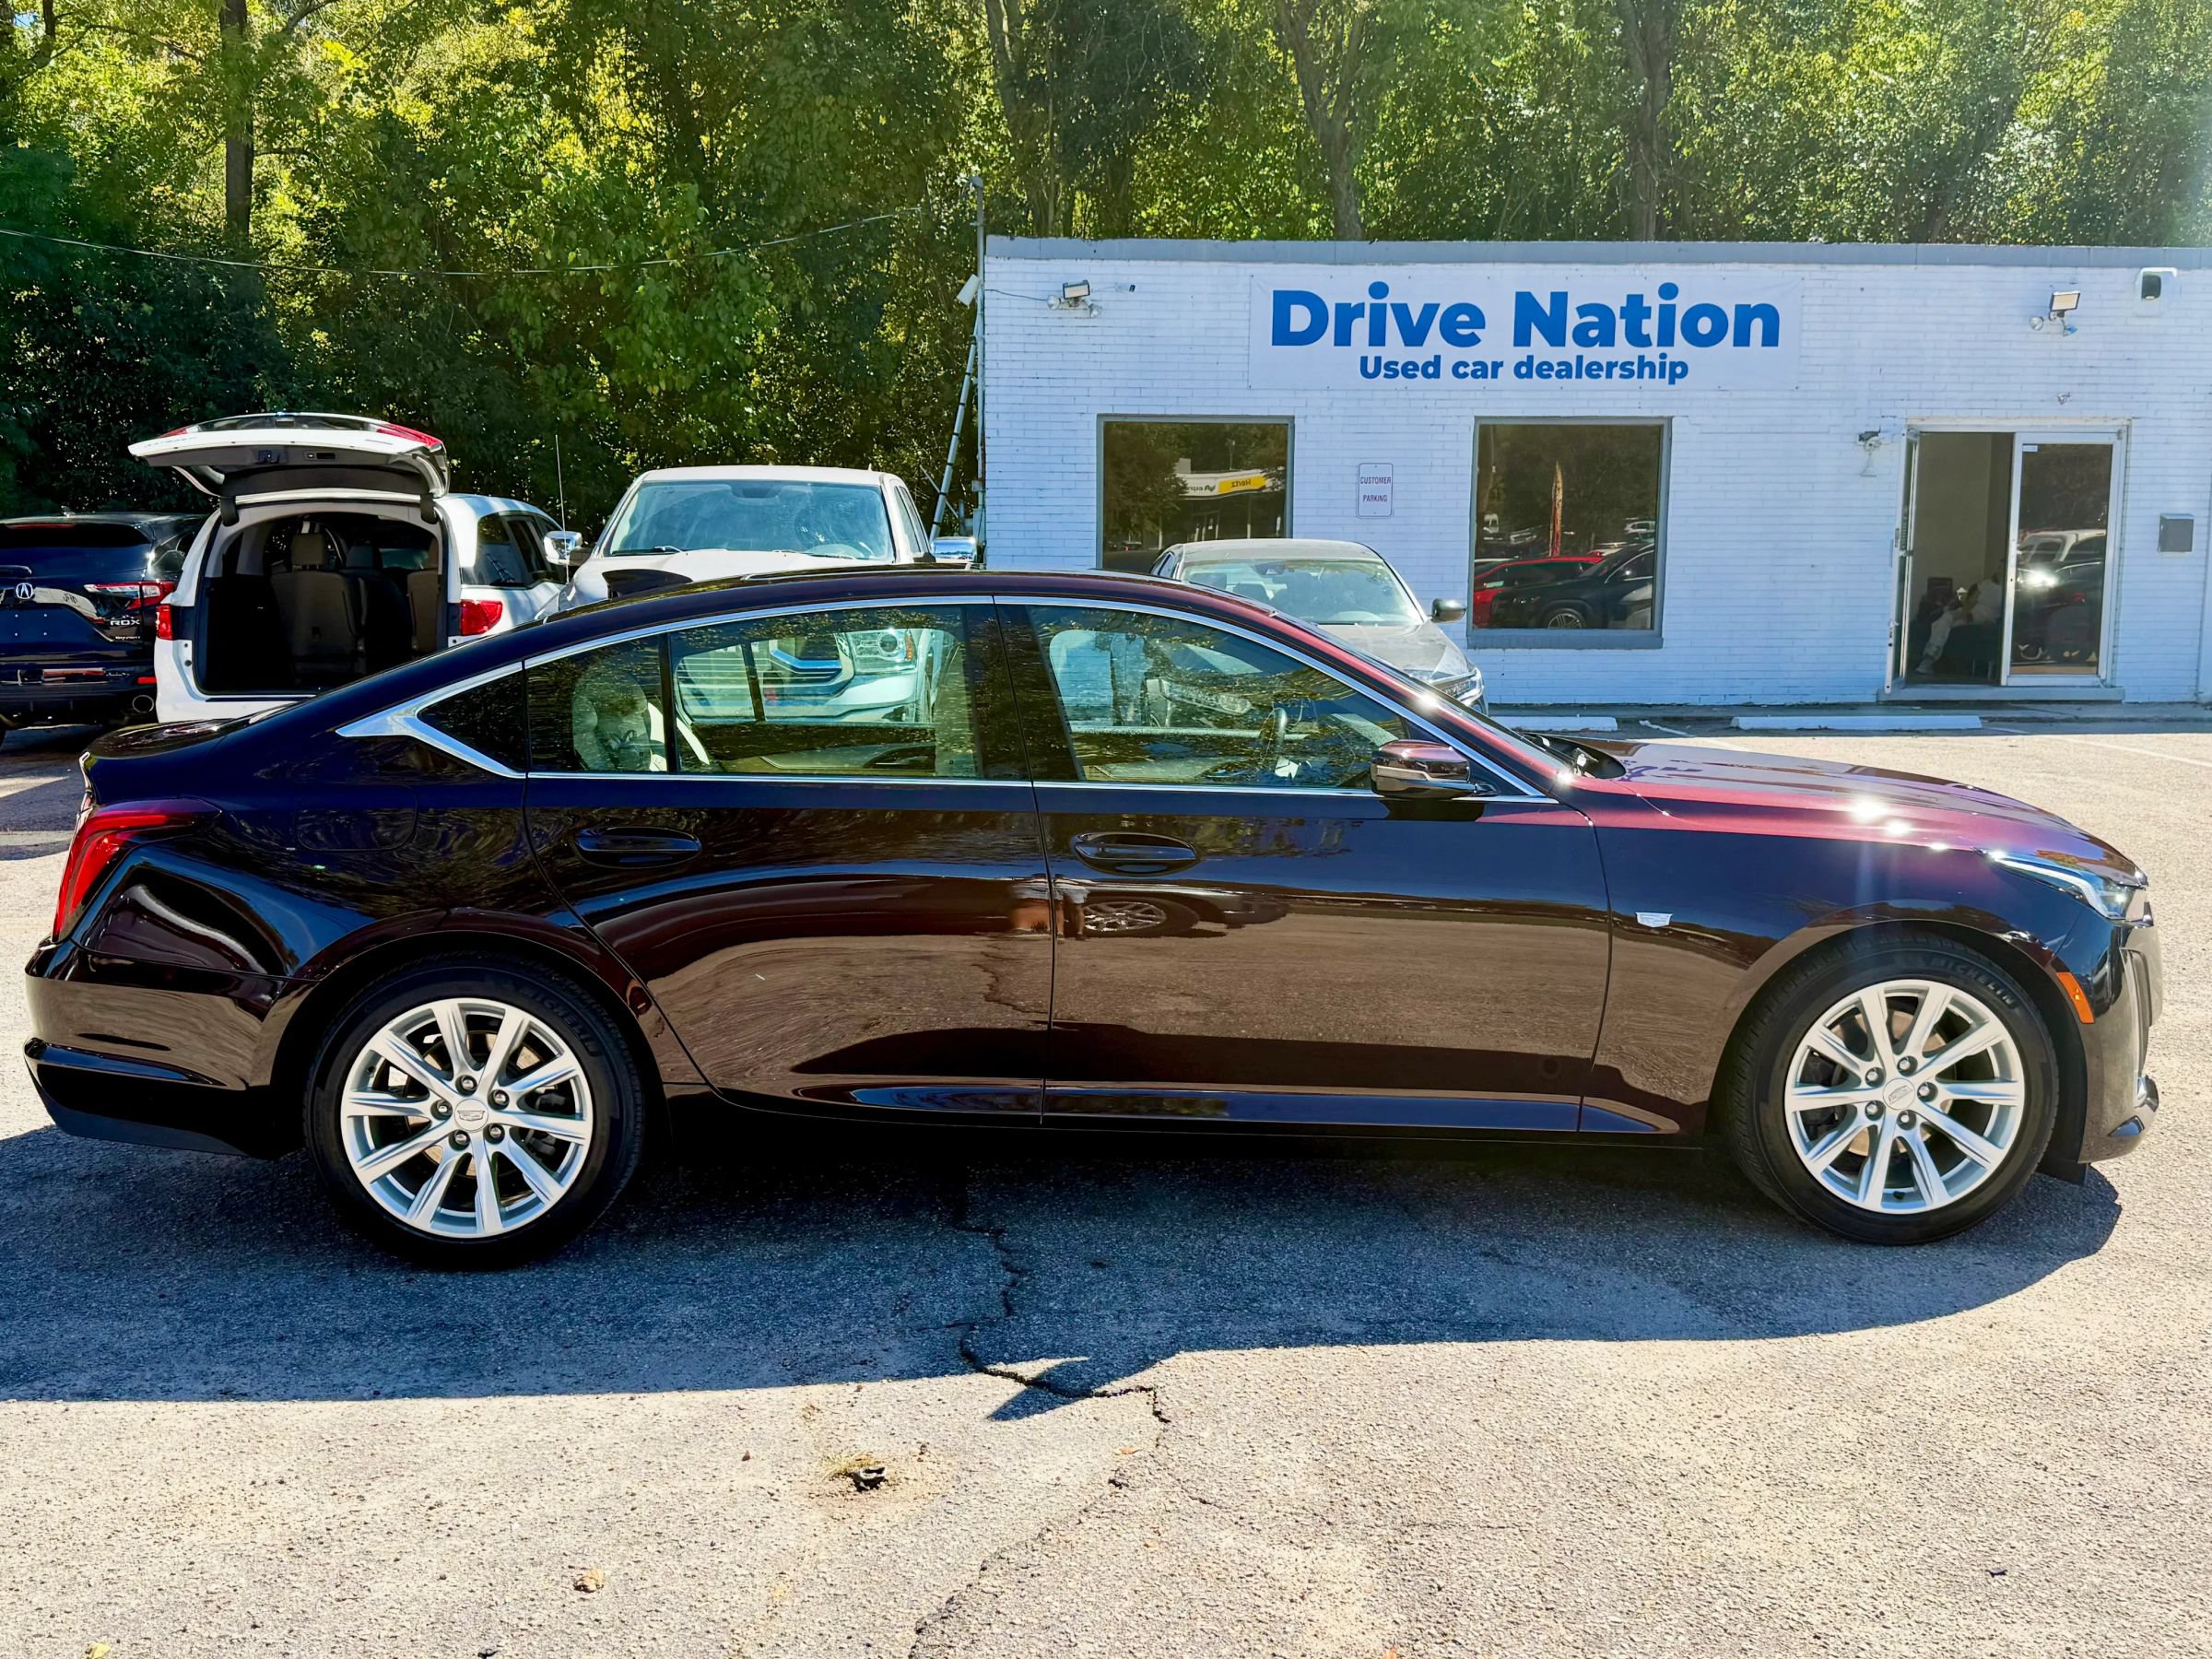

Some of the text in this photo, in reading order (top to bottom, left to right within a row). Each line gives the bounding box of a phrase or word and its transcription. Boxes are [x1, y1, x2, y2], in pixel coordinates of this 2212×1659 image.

[1272, 281, 1780, 347] Drive Nation
[1360, 353, 1688, 384] Used car dealership
[1359, 477, 1392, 485] CUSTOMER
[1362, 494, 1388, 502] PARKING
[1929, 956, 2015, 1006] MICHELIN
